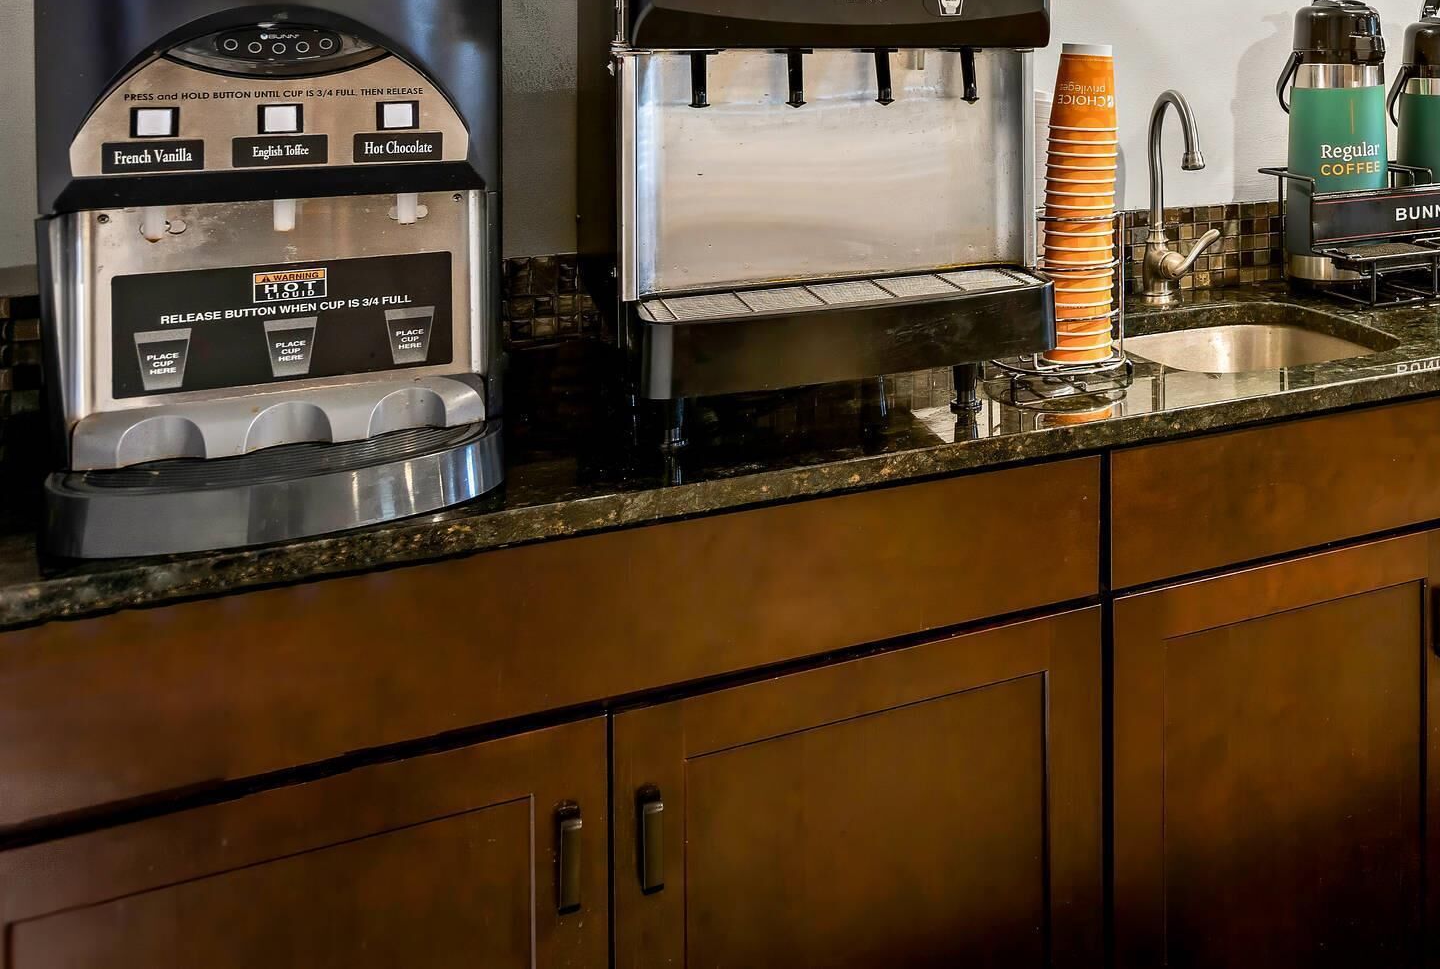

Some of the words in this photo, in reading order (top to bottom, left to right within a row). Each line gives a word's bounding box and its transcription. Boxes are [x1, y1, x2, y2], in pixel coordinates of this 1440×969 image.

[124, 93, 154, 101] PRESS
[181, 92, 210, 100] HOLD
[213, 91, 250, 99] BUTTON
[254, 90, 280, 98] UNTIL
[317, 88, 333, 97] 3/4
[361, 88, 383, 96] THEN
[386, 87, 424, 95] RELEASE
[1057, 95, 1106, 107] CHOICE
[252, 144, 283, 160] English
[284, 143, 309, 156] Toffee
[364, 141, 384, 155] Hot
[386, 139, 433, 154] Chocolate
[1320, 142, 1380, 162] Regular
[114, 149, 151, 165] French
[154, 147, 192, 163] Vanilla
[1320, 161, 1381, 176] COFFEE
[273, 271, 319, 281] WARNING
[265, 281, 316, 294] HOT
[267, 289, 315, 300] LIQUID
[160, 311, 222, 325] RELEASE
[225, 306, 276, 319] BUTTON
[280, 303, 317, 315] WHEN
[320, 300, 345, 310] CUP
[348, 299, 360, 308] IS
[362, 297, 379, 307] 3/4
[382, 295, 412, 304] FULL
[396, 328, 425, 337] PLACE
[275, 340, 306, 349] PLACE
[398, 342, 422, 350] HERE
[146, 352, 180, 361] PLACE
[281, 347, 301, 355] CUP
[278, 354, 304, 362] HERE
[152, 360, 174, 368] CUP
[150, 367, 177, 375] HERE
